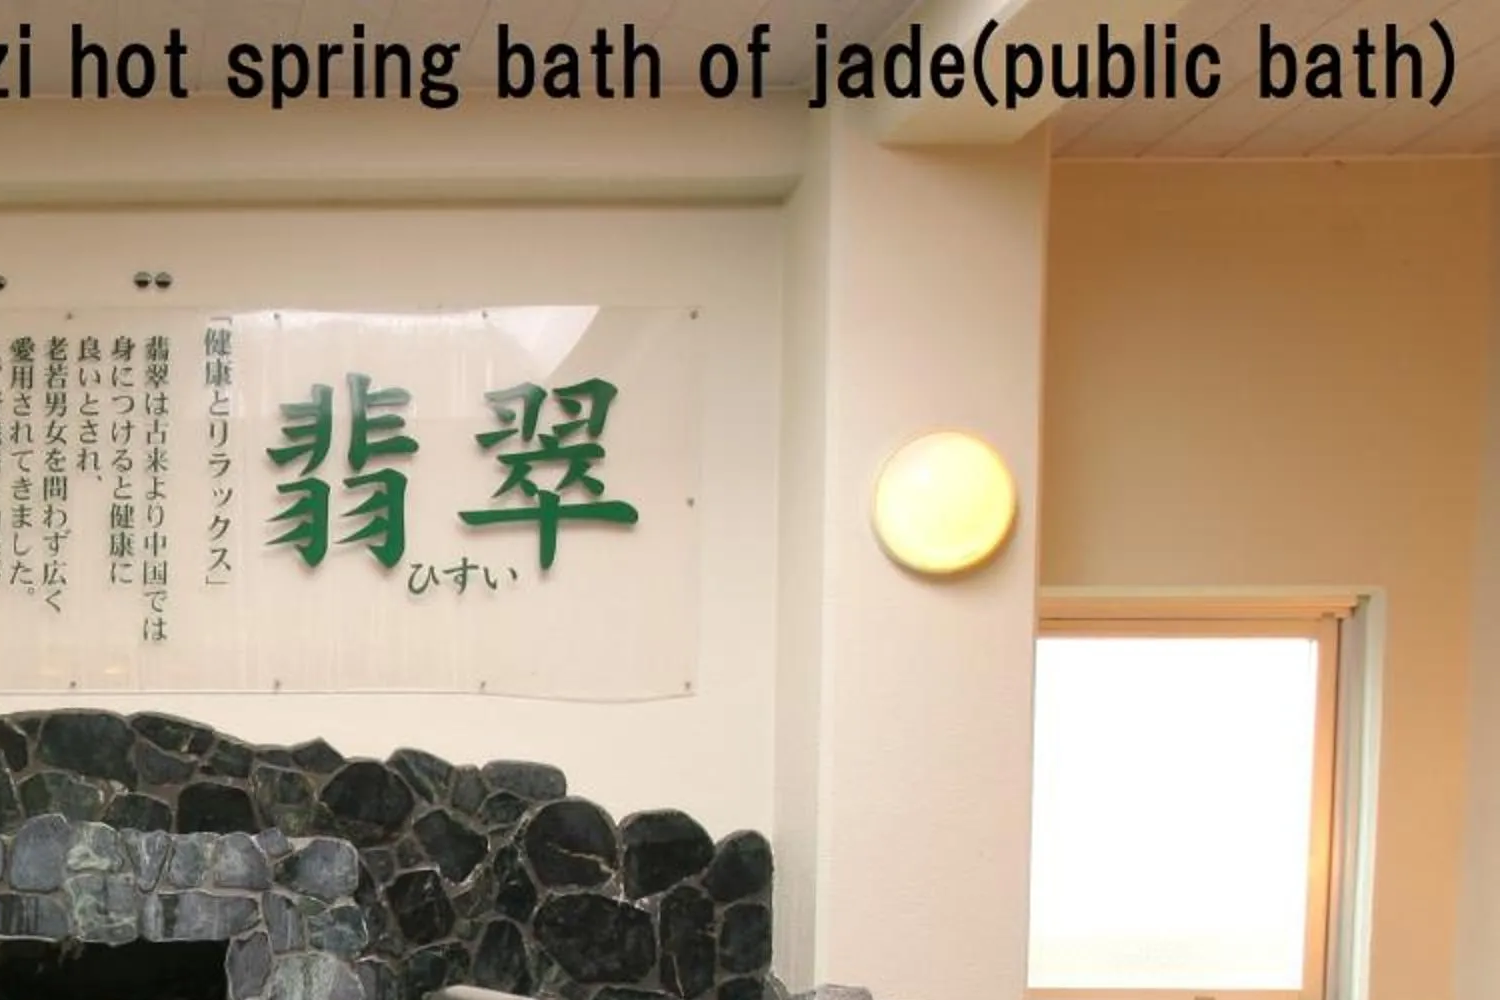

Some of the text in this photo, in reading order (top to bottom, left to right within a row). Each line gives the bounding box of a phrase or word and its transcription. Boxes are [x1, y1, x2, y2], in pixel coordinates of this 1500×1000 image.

[10, 336, 36, 597] 愛用されてきました。
[43, 336, 69, 613] 老若男女を問わず広く
[77, 336, 103, 483] 良いとされ、
[110, 336, 136, 585] 身につけると健康に
[143, 336, 169, 642] 翡翠は古来より中国では
[264, 372, 639, 570] 翡翠
[407, 557, 518, 595] ひすい
